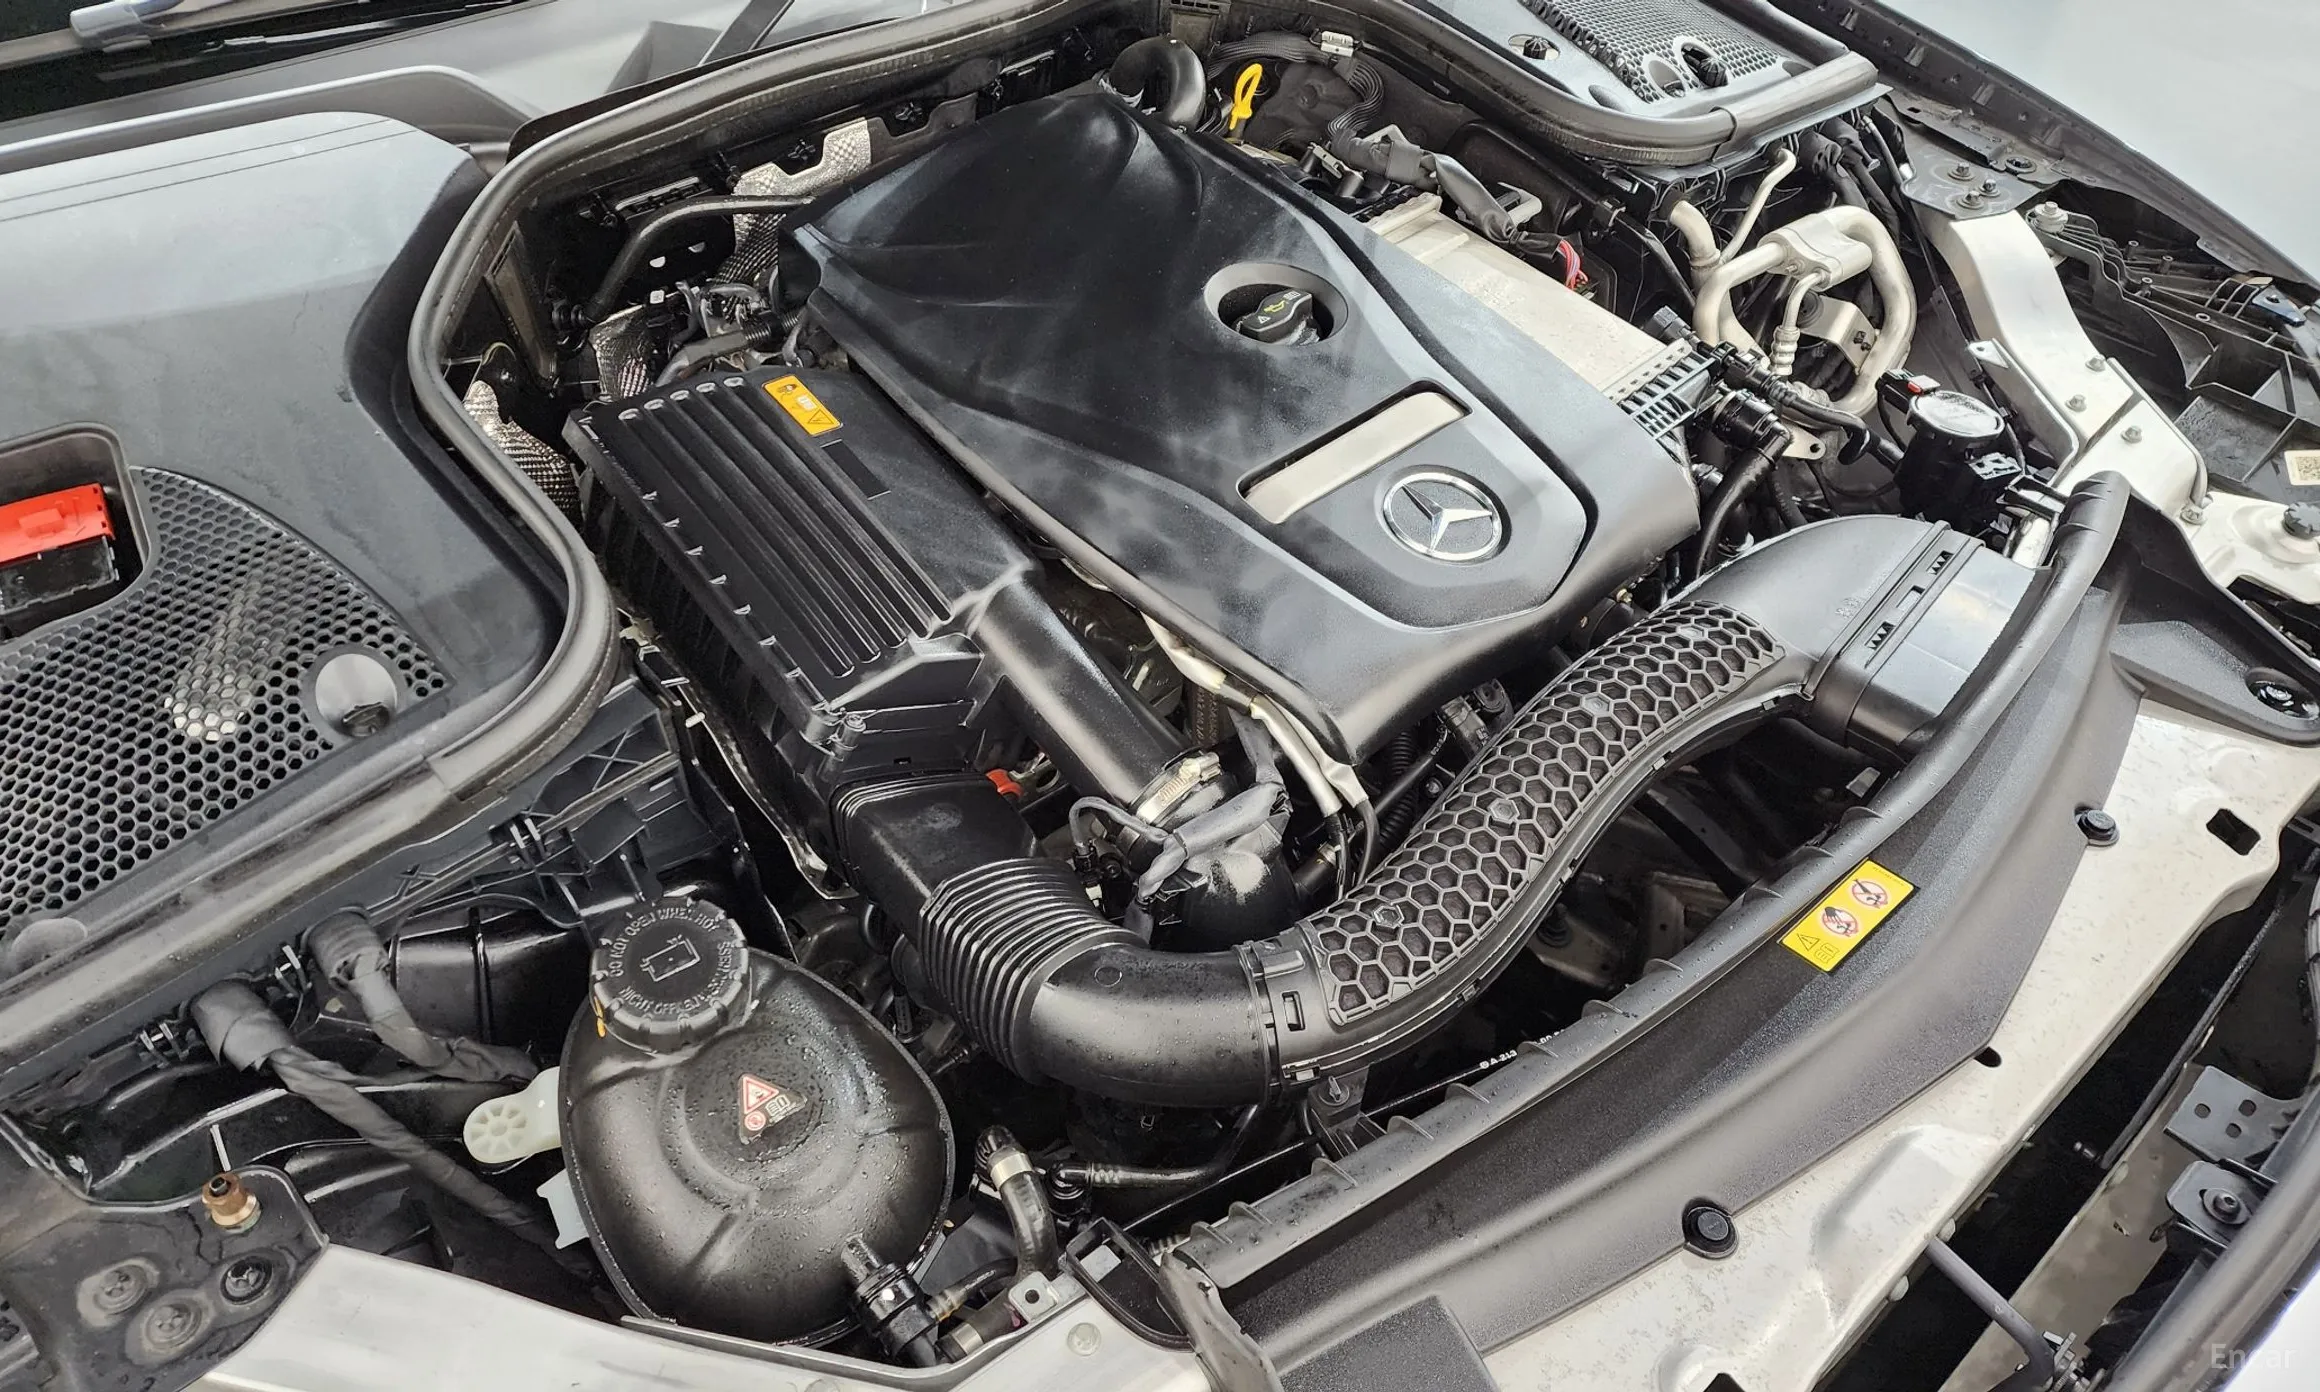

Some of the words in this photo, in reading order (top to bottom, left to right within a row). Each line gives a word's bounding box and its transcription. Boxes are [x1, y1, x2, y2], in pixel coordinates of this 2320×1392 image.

[609, 936, 630, 958] NOT
[624, 912, 656, 936] OPEN
[694, 913, 720, 932] HOT
[618, 985, 654, 1012] NICHT
